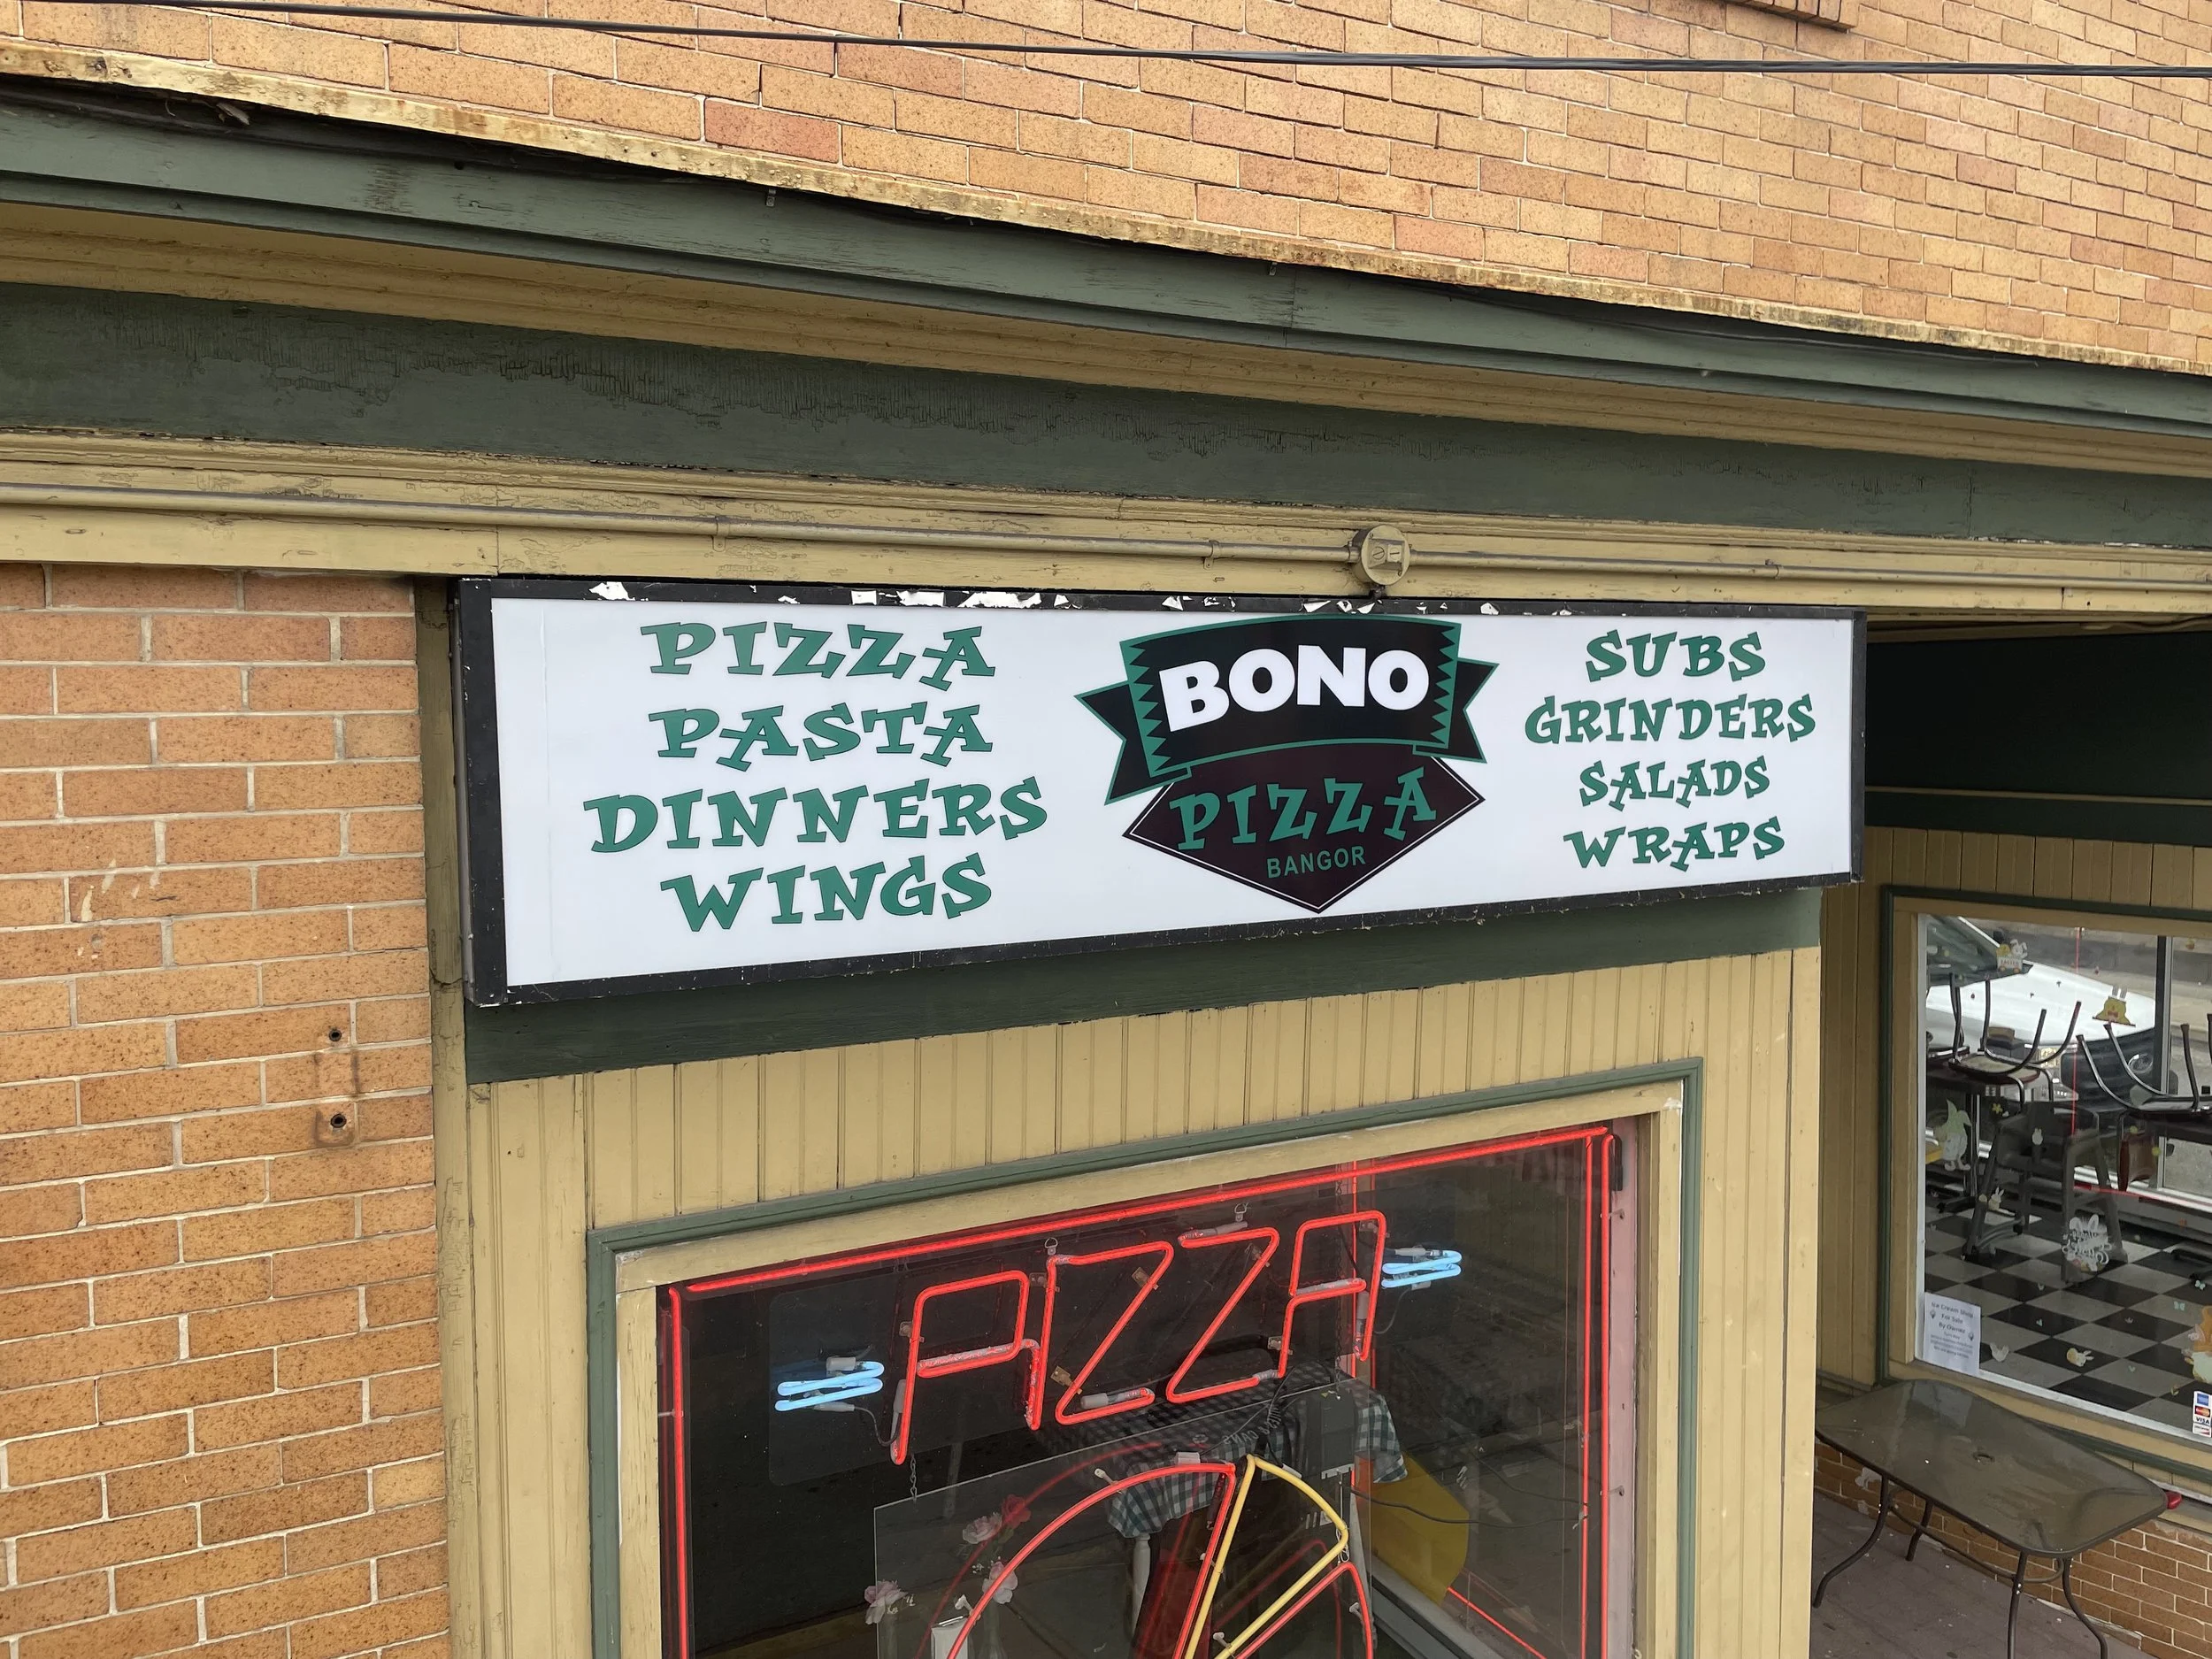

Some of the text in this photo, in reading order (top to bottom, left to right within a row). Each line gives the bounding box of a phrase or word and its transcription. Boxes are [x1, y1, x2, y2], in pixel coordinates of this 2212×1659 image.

[640, 620, 996, 692] PIZZA
[1158, 644, 1430, 733] BONO
[1585, 629, 1766, 682] SUBS
[648, 701, 994, 772] PASTA
[1525, 693, 1816, 745] GRINDERS
[582, 775, 1048, 853] DINNERS
[1168, 765, 1437, 851] PIZZA
[1578, 755, 1770, 812] SALADS
[1266, 845, 1367, 879] BANGOR
[1563, 816, 1786, 872] WRAPS
[659, 851, 992, 933] WINGS
[890, 1210, 1386, 1464] PIZZA
